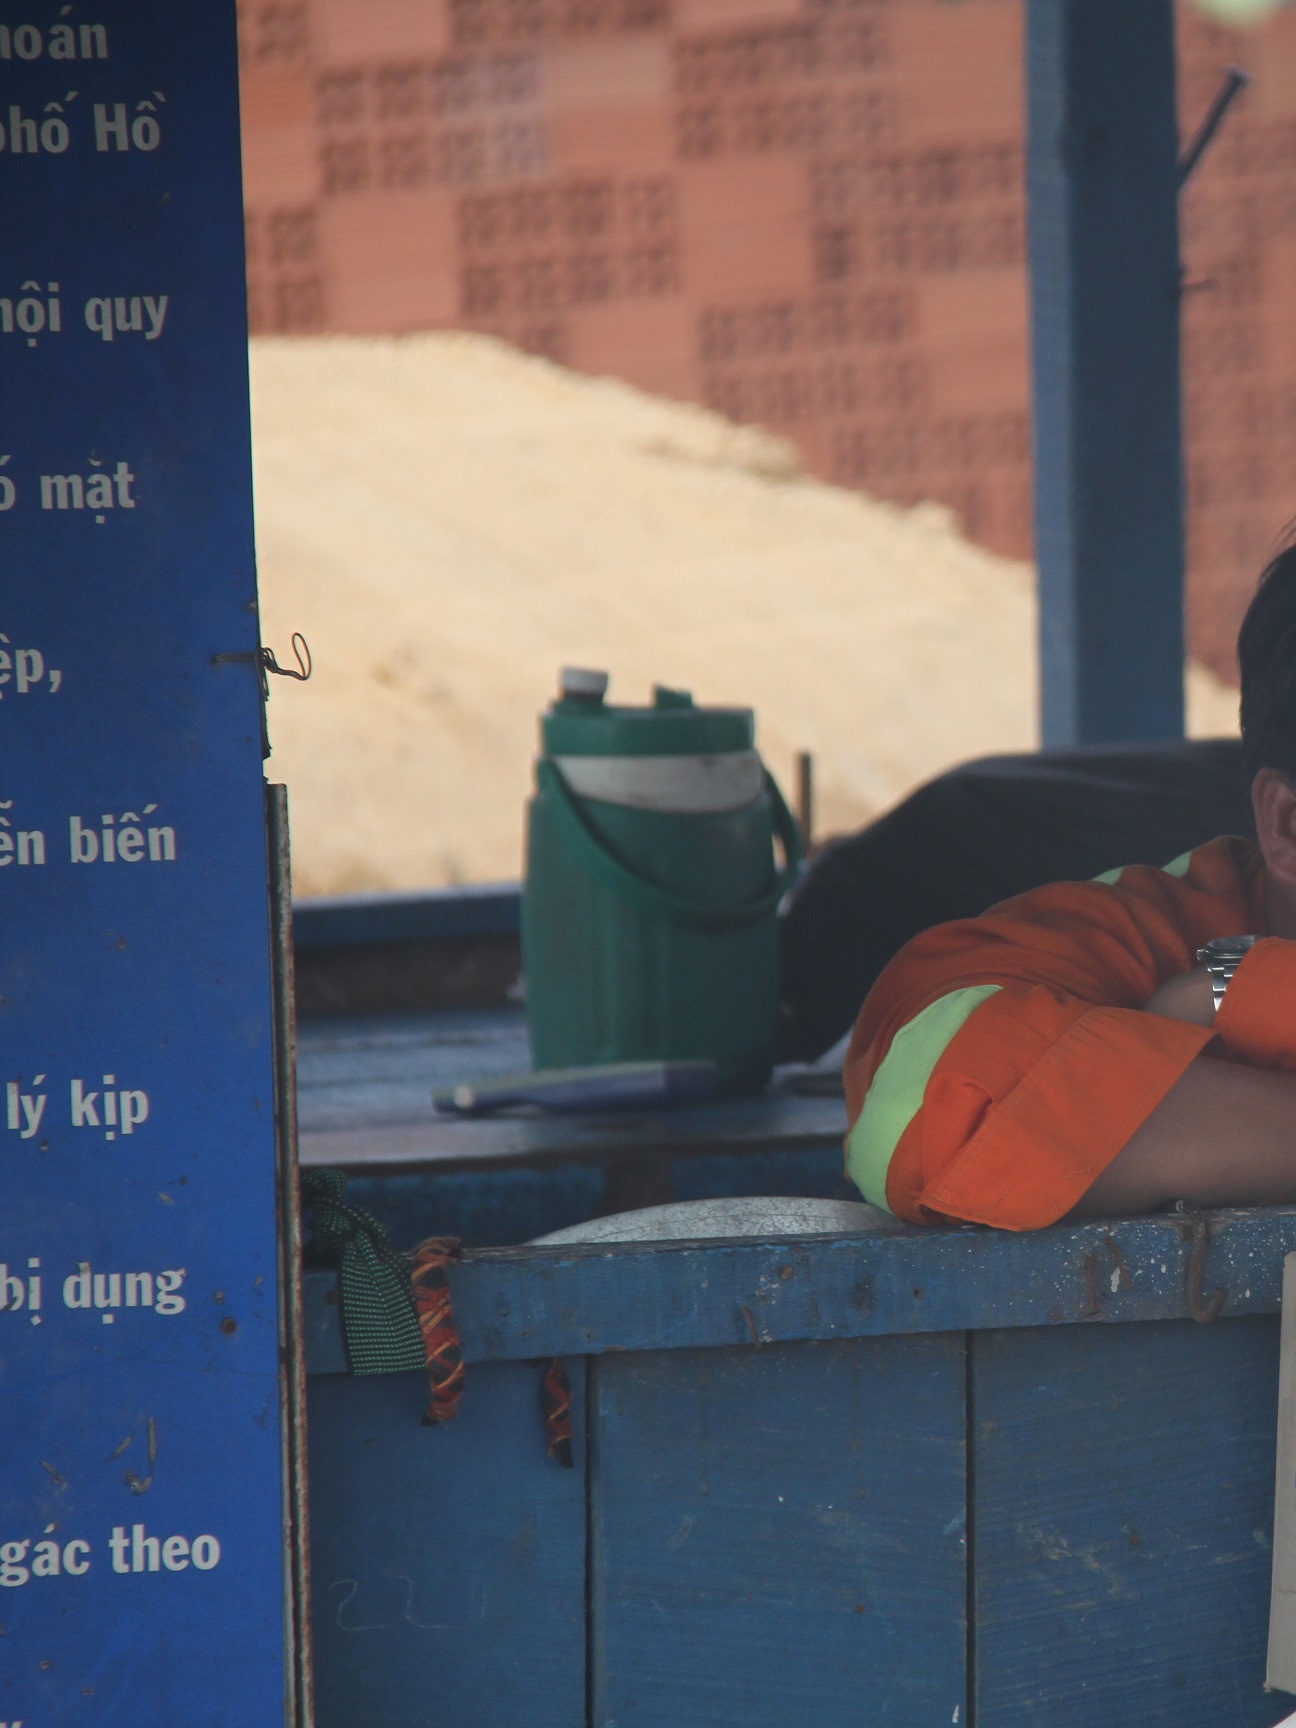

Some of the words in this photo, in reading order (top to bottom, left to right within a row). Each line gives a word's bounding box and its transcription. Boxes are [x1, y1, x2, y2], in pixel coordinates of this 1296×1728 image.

[0, 91, 78, 153] hố
[93, 91, 166, 151] Hồ
[84, 295, 168, 341] quy
[40, 457, 136, 524] mặt
[69, 803, 176, 863] biến
[6, 1074, 47, 1139] lý
[70, 1074, 148, 1140] kịp
[63, 1261, 188, 1325] dụng
[0, 1523, 90, 1587] gác
[109, 1524, 220, 1573] theo
